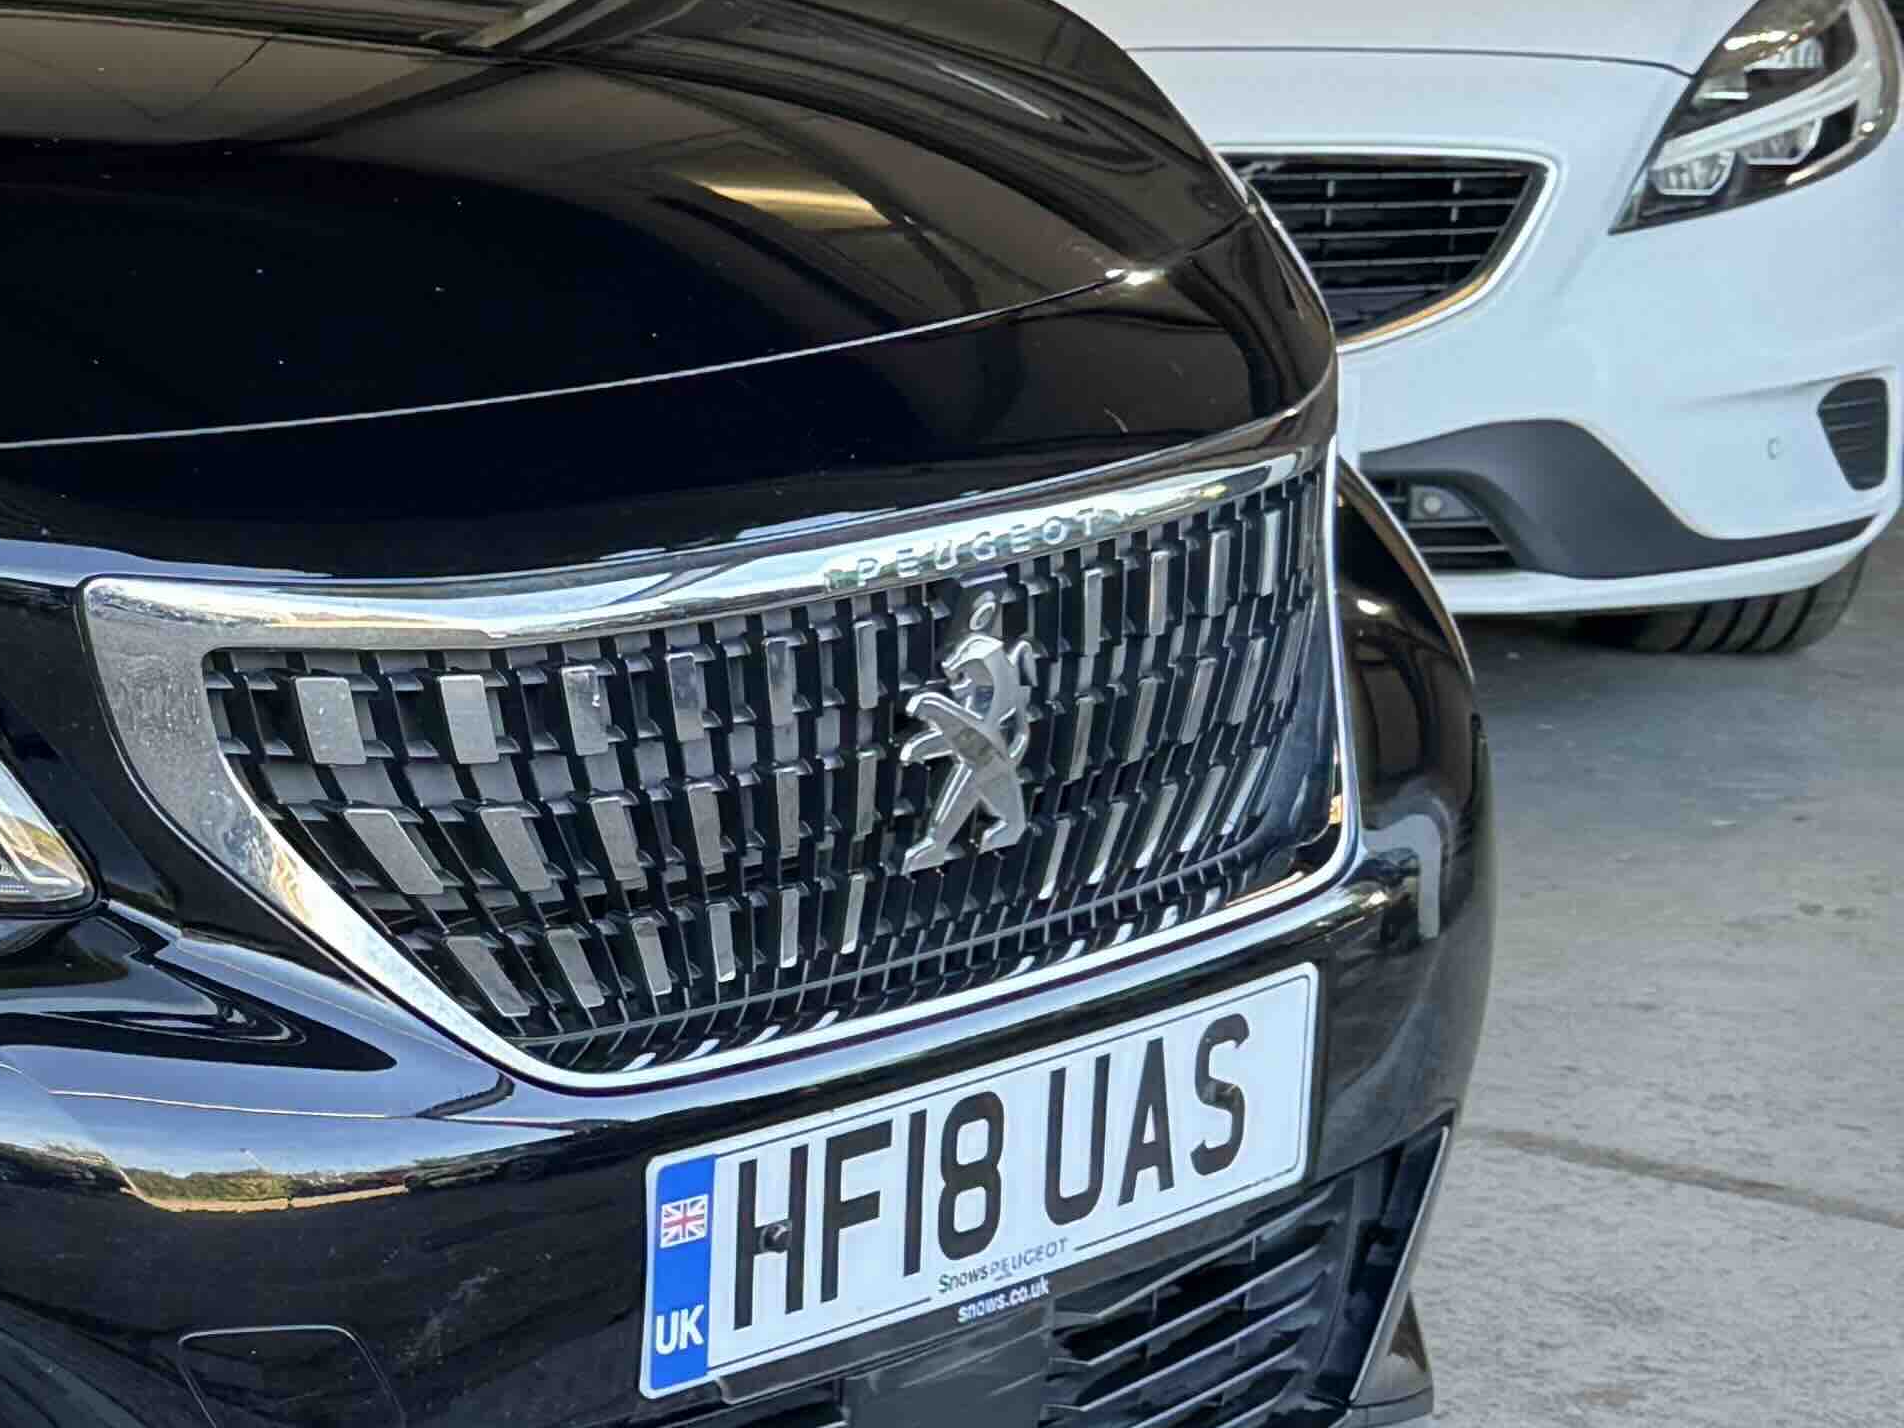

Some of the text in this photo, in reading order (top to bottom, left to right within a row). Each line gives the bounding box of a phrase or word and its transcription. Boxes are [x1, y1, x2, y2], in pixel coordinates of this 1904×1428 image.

[855, 508, 1096, 586] PEUGEOT
[733, 1012, 1250, 1331] HF18 UAS
[938, 1238, 1069, 1294] Snows PEUGEOT
[956, 1276, 1051, 1324] snows.co.uk
[654, 1303, 706, 1356] UK
